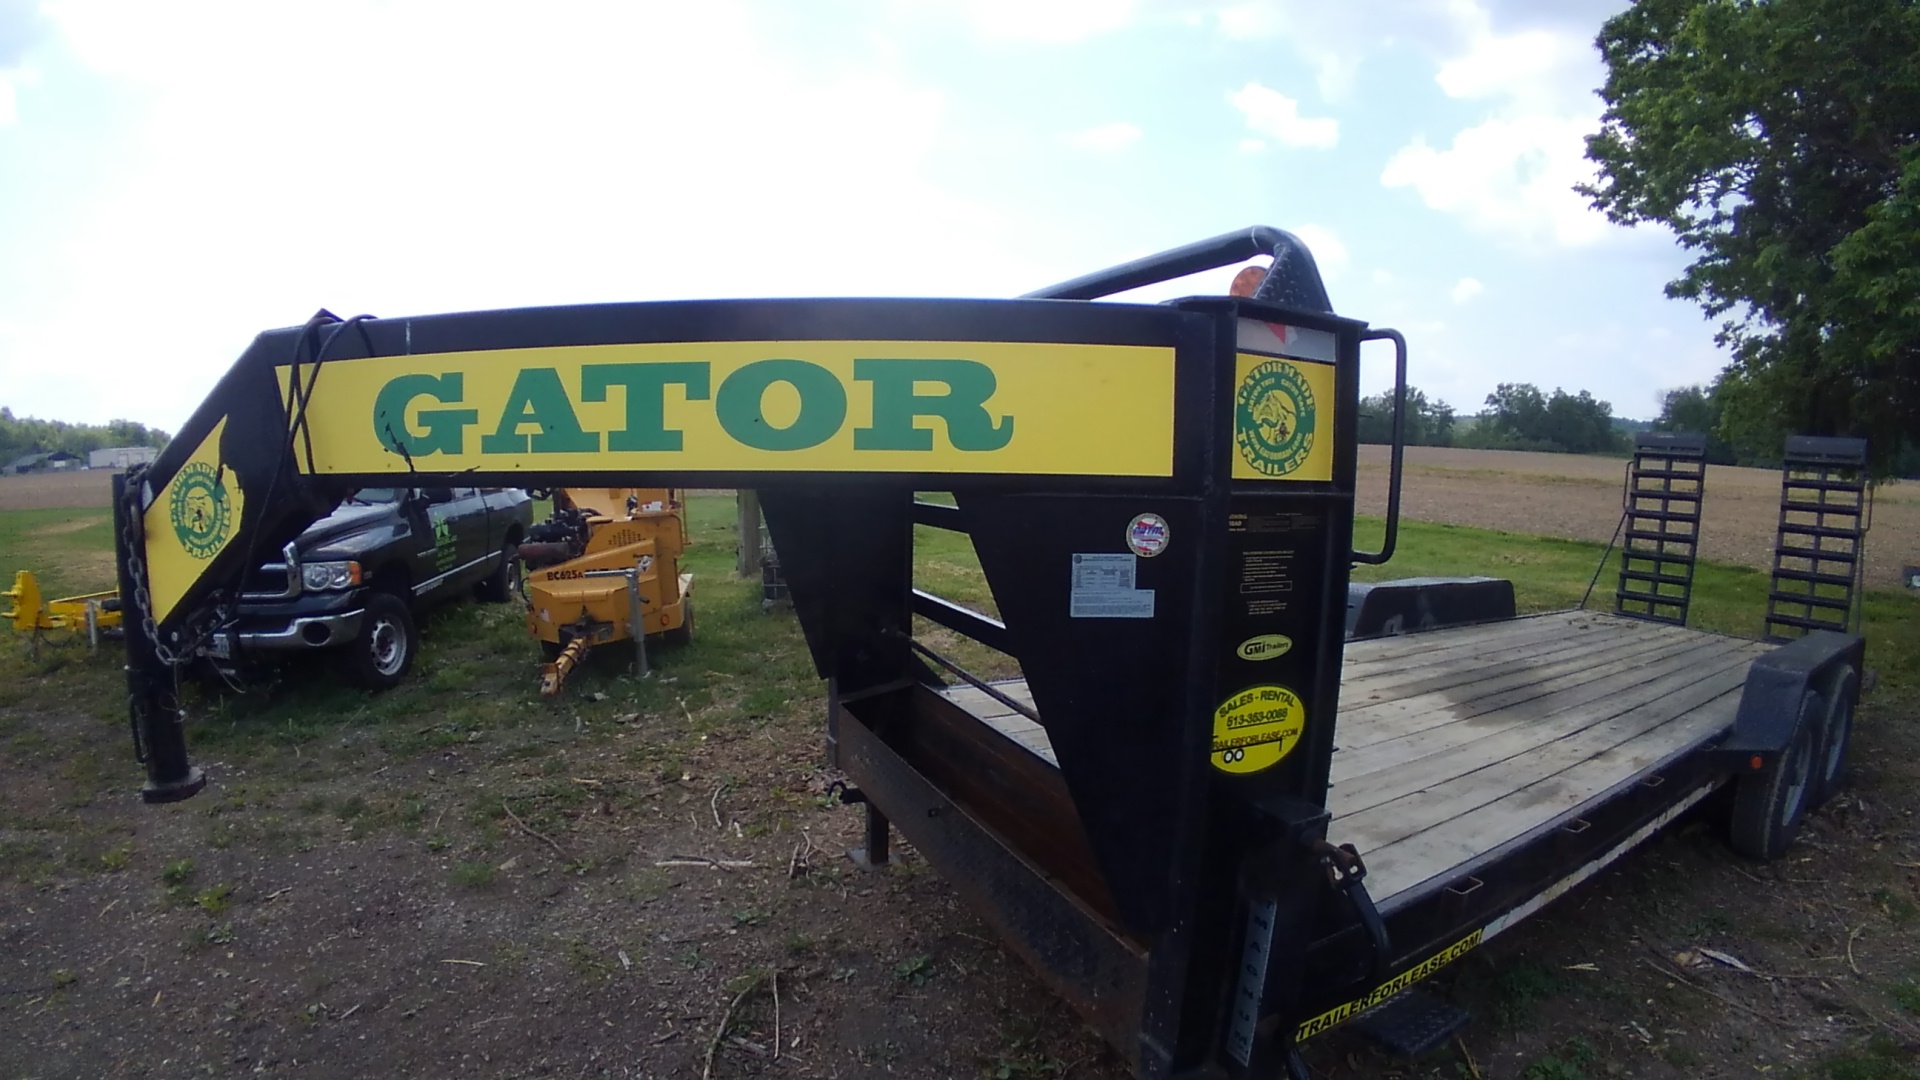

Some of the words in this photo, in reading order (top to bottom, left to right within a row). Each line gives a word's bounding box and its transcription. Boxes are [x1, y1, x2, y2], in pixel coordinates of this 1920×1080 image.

[374, 358, 1013, 457] GATOR
[1237, 427, 1313, 476] TRAILERS
[1219, 693, 1254, 718] SALES
[1260, 690, 1294, 707] RENTAL
[1299, 933, 1480, 1040] TRAILERFORLEASE.COM
